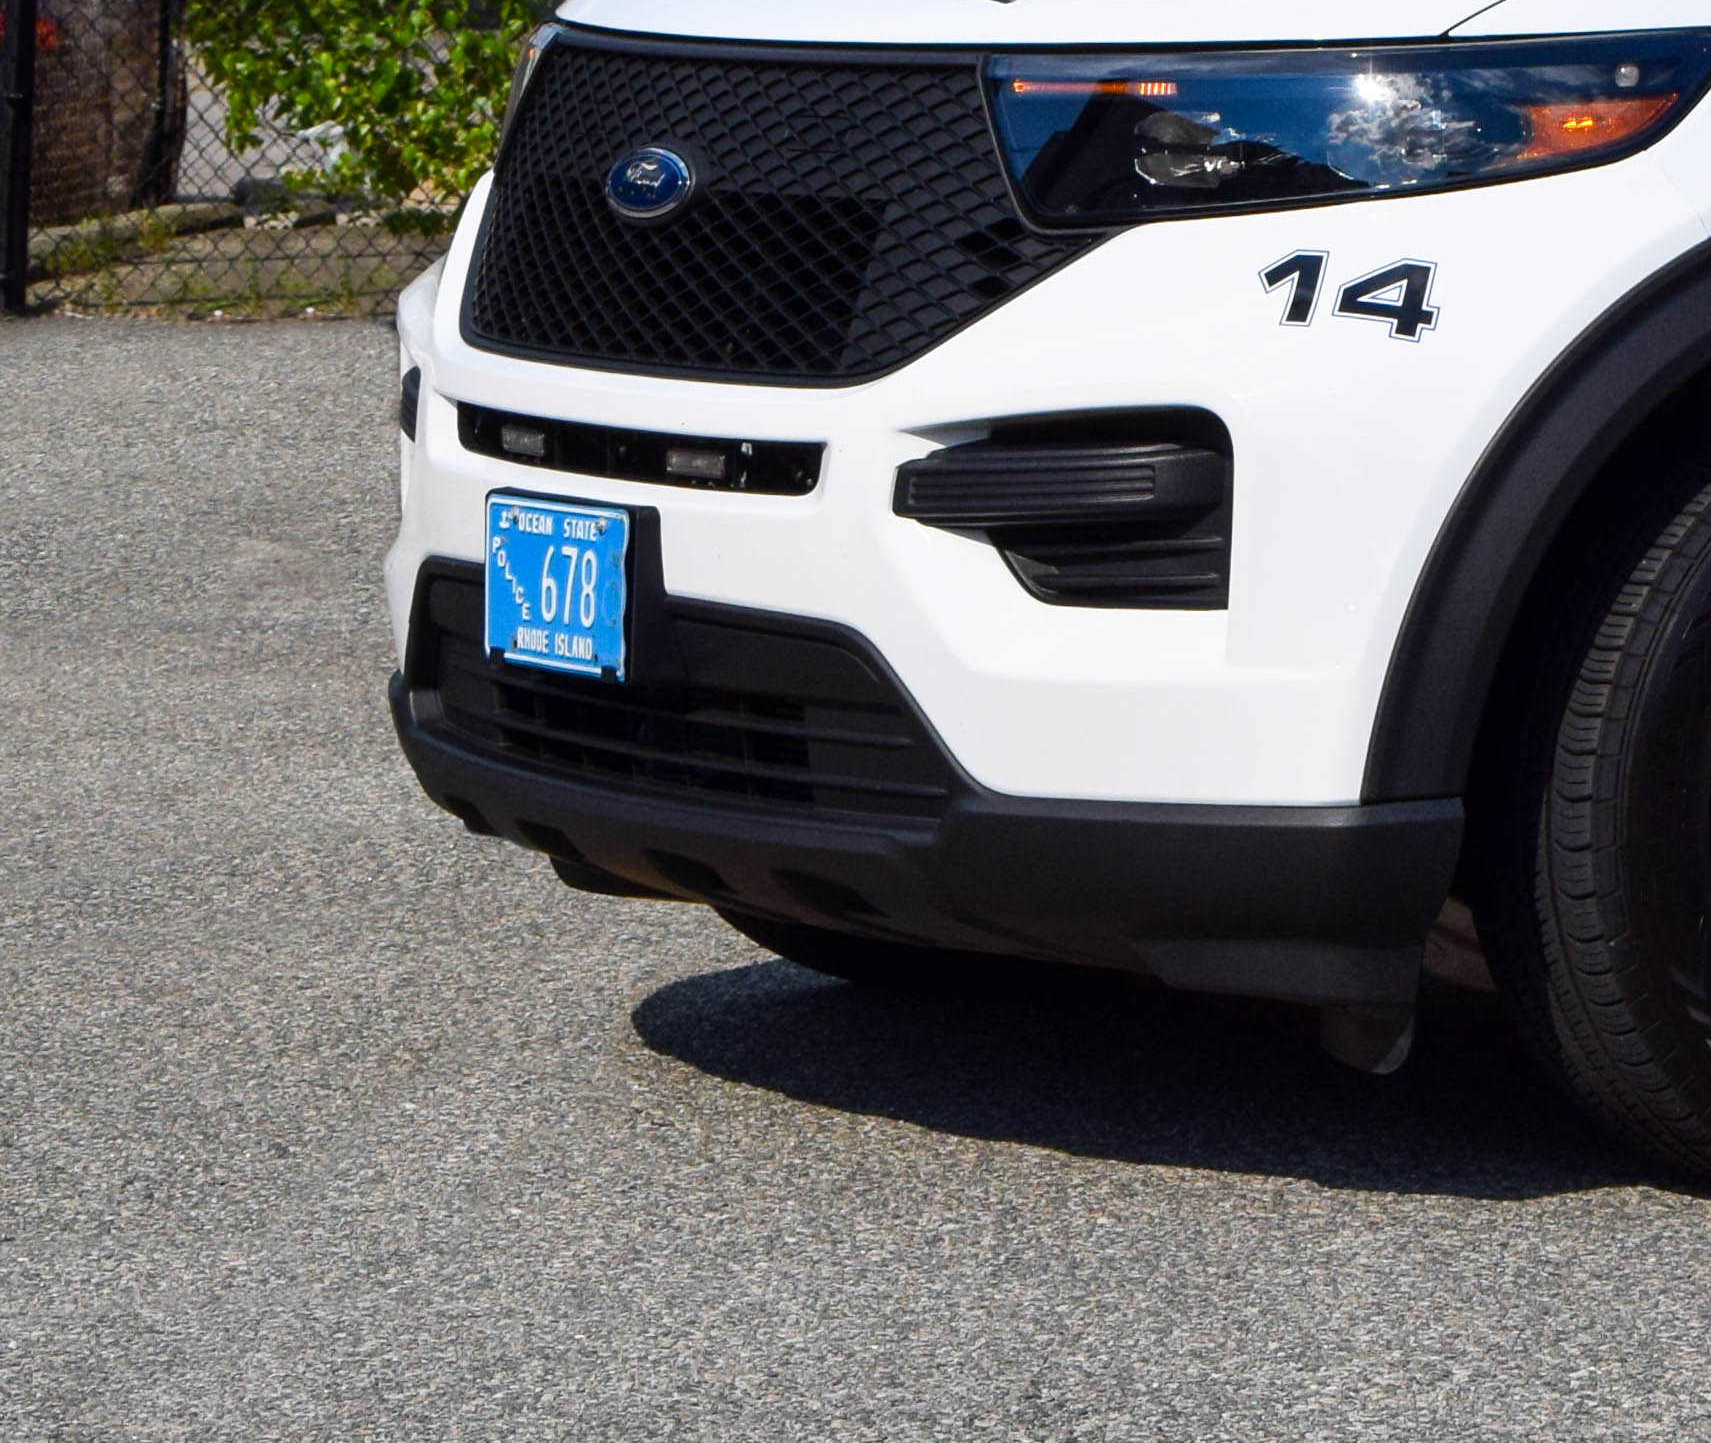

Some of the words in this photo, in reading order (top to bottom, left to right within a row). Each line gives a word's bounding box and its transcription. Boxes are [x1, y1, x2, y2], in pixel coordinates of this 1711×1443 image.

[1258, 249, 1440, 343] 14
[518, 512, 553, 536] OCEAN
[563, 518, 597, 542] STATE
[492, 536, 531, 621] POLICE
[541, 545, 598, 629] 678
[516, 627, 549, 652] RHODE
[554, 632, 593, 660] ISLAND
